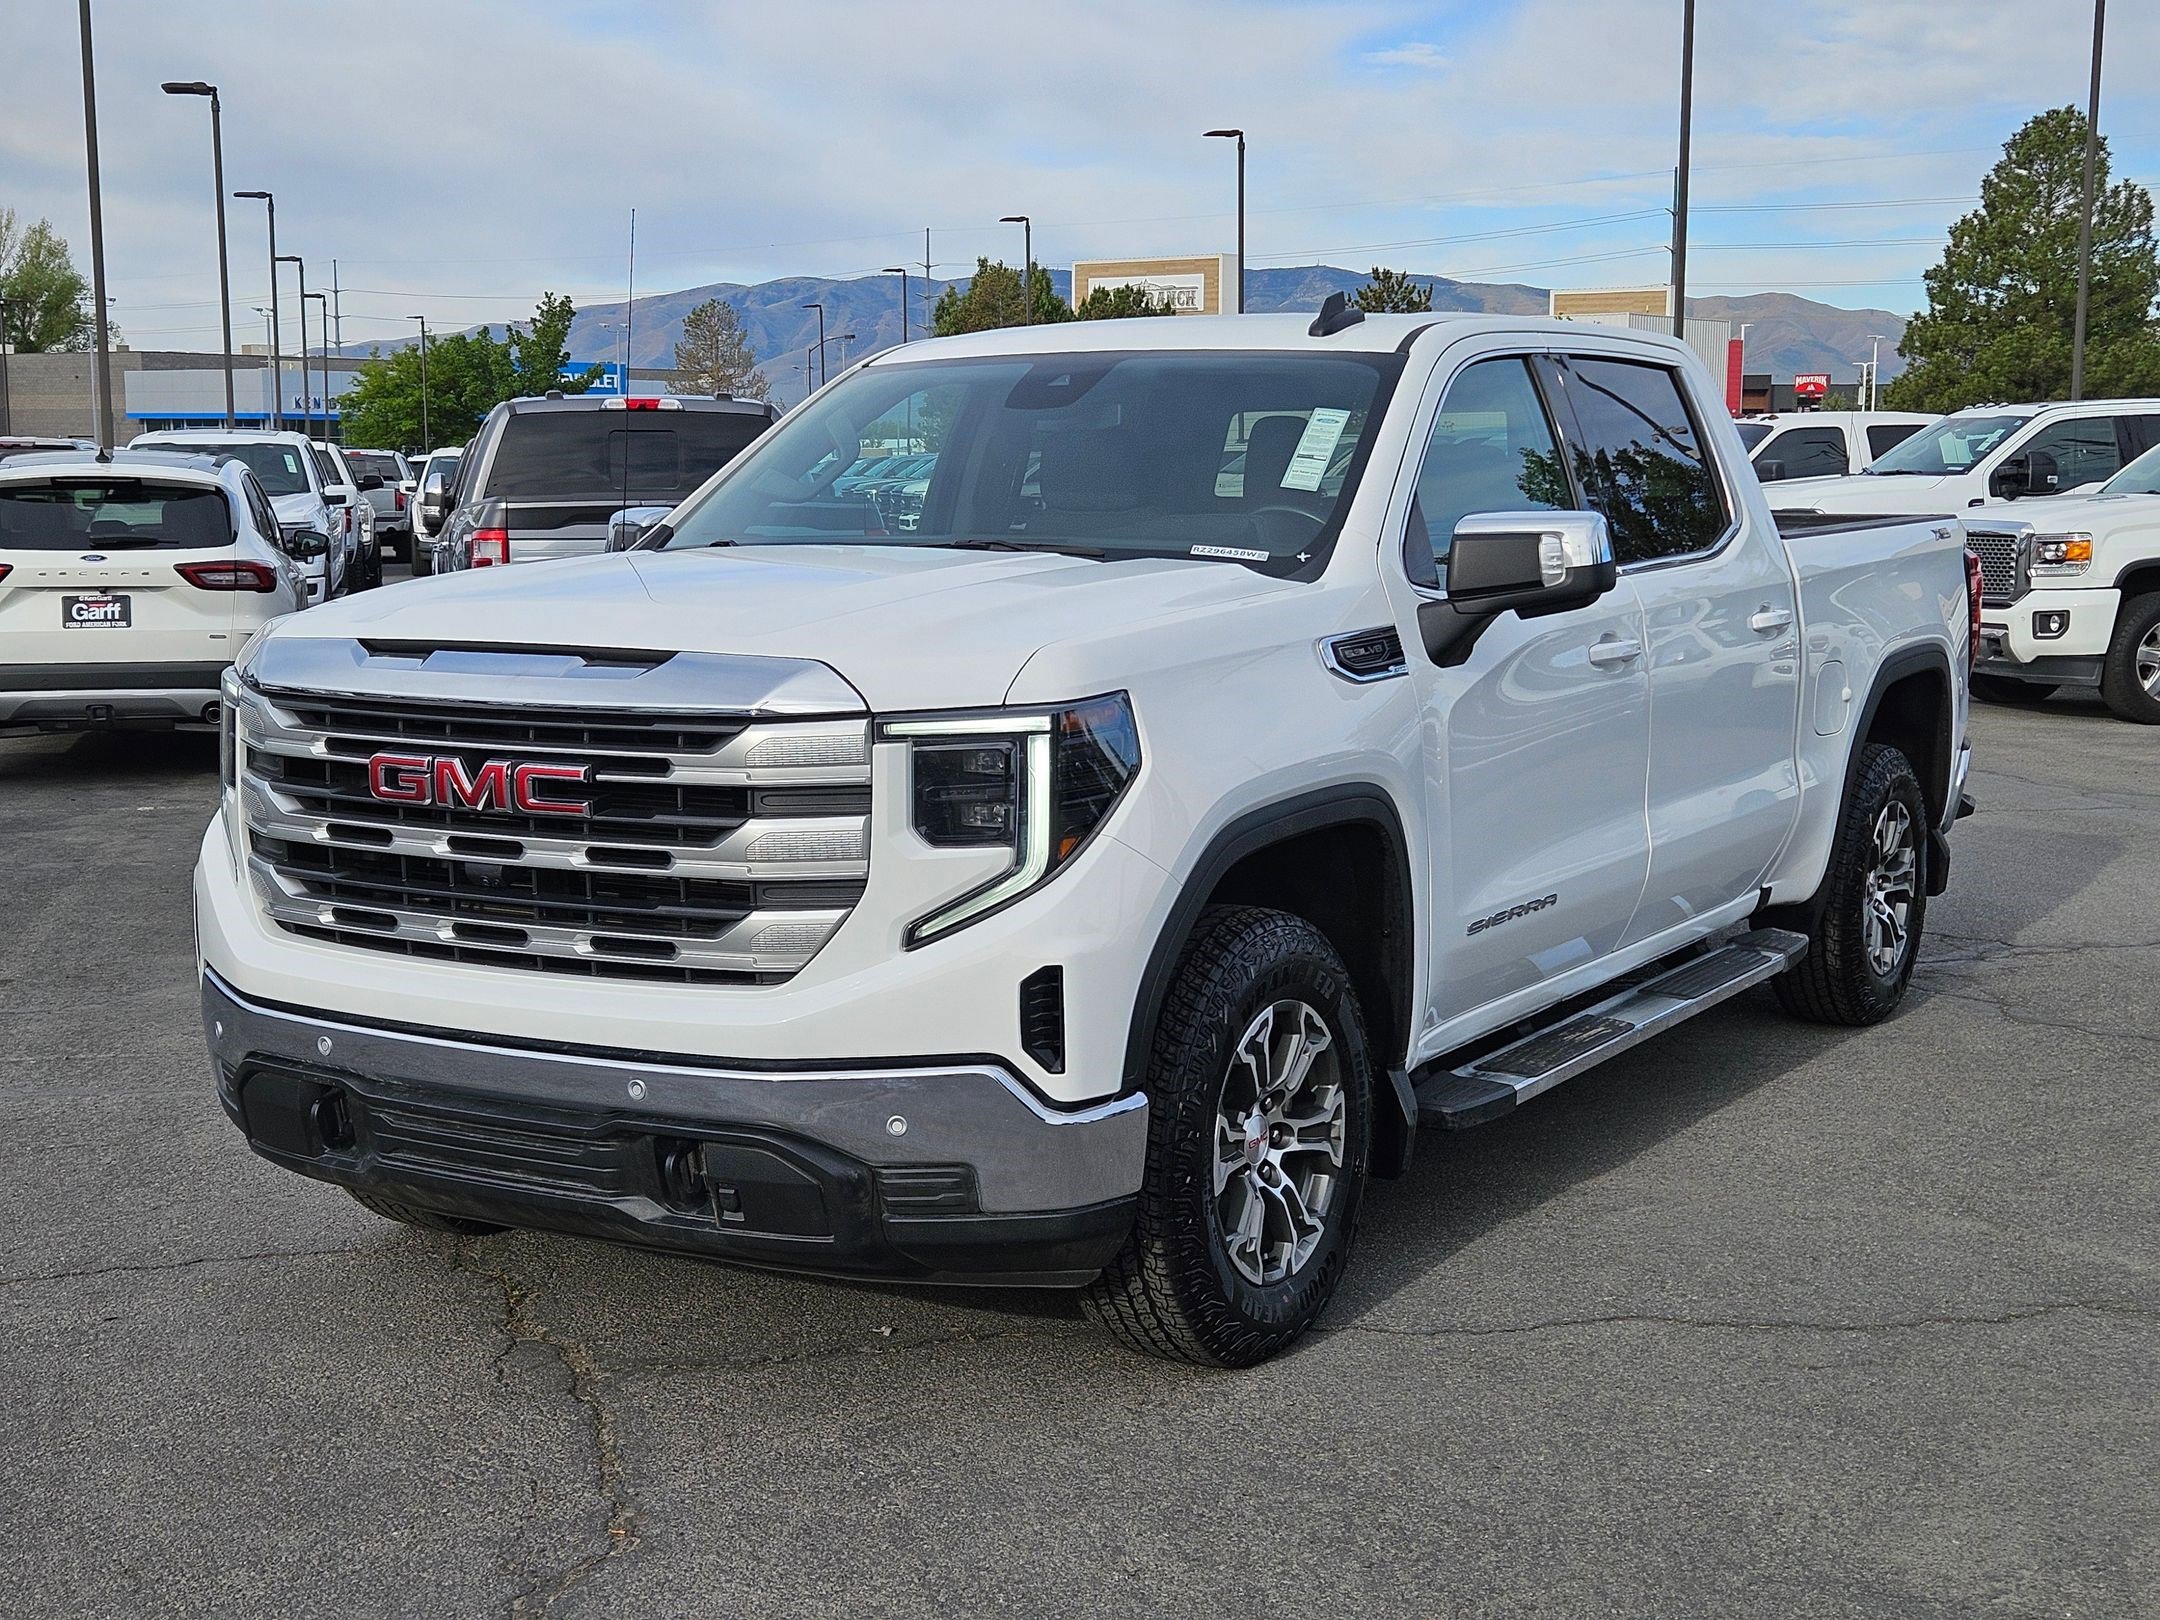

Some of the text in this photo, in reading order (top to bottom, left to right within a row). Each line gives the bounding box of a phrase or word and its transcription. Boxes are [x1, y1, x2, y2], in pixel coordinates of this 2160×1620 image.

[1795, 375, 1828, 388] MAVERIK
[71, 602, 121, 621] Garff
[368, 752, 594, 819] GMC
[1466, 893, 1558, 936] SIERRA
[1248, 1130, 1268, 1149] GMC
